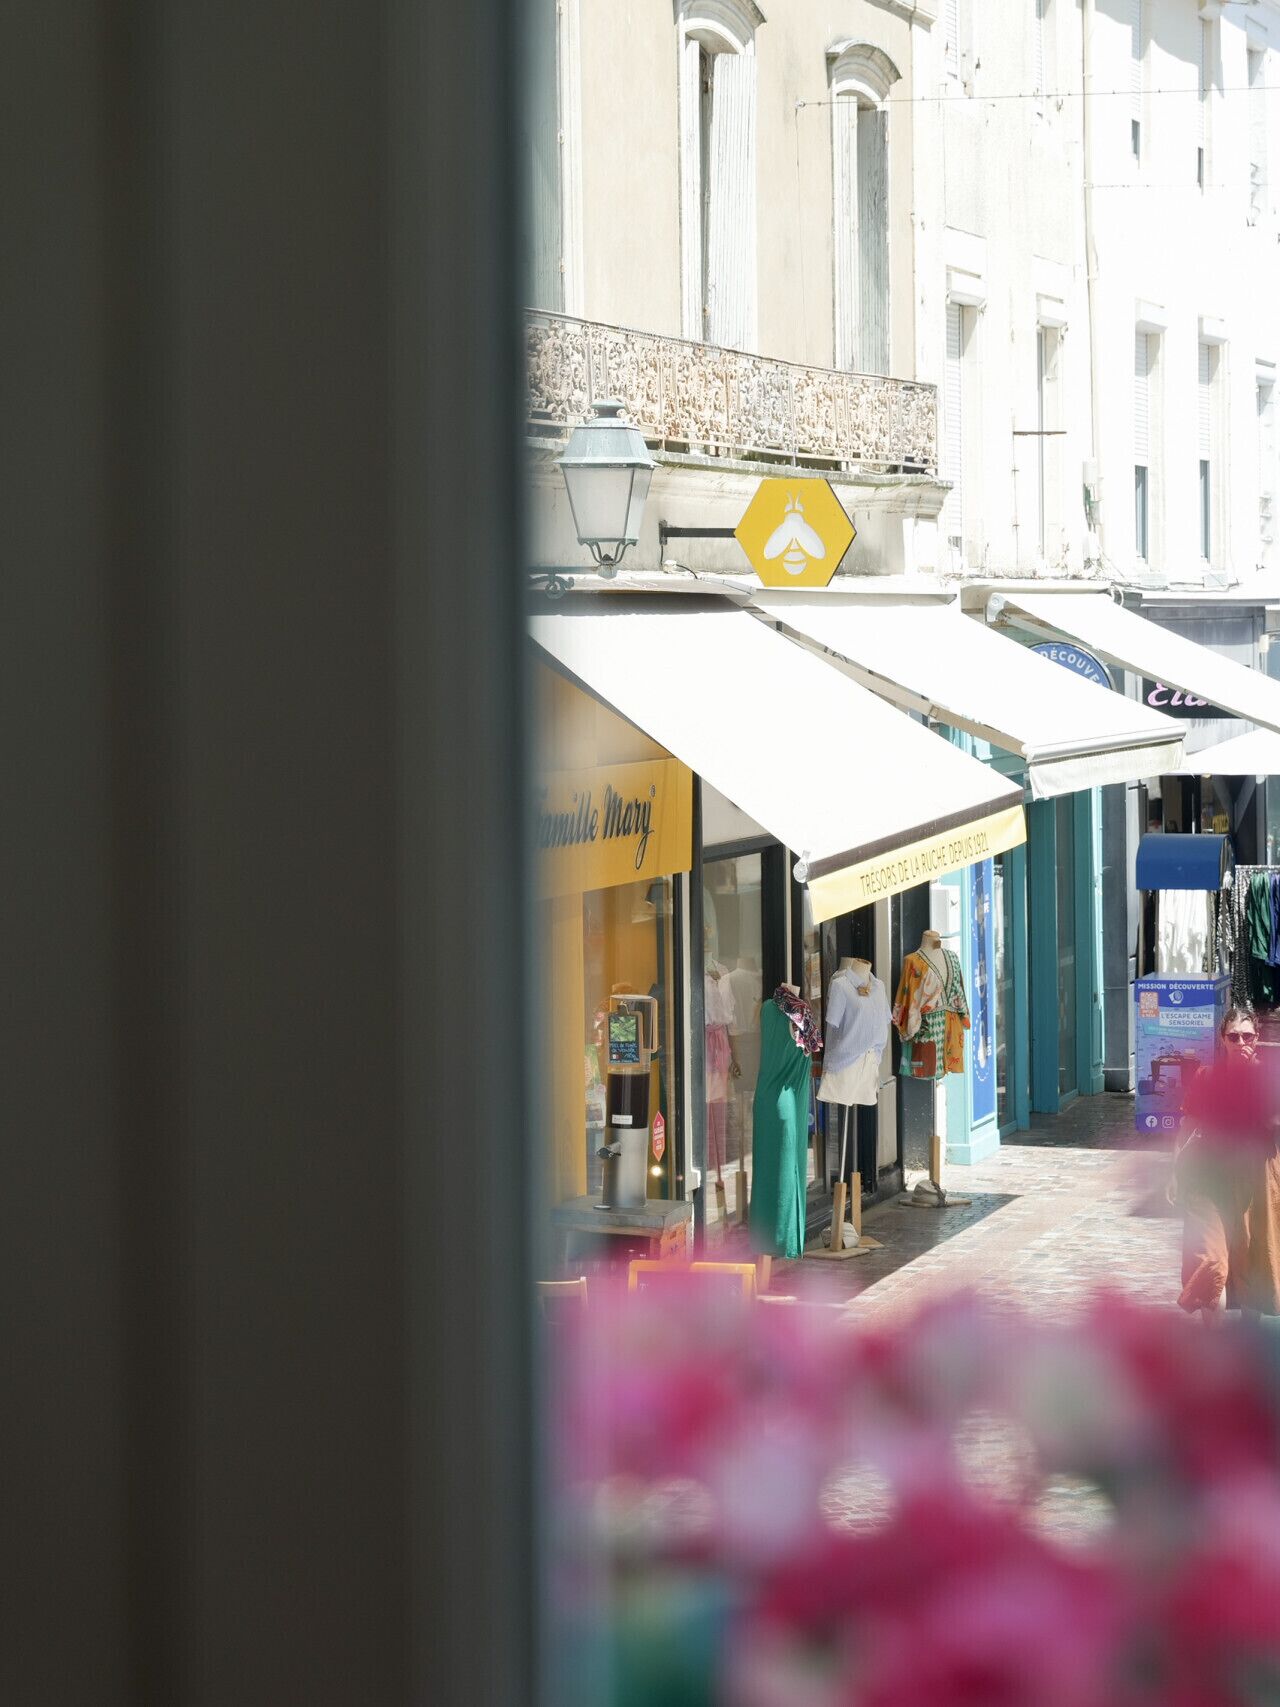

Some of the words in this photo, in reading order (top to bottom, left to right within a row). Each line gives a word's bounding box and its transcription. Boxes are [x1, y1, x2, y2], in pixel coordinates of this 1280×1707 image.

[860, 864, 897, 897] TRÉSORS
[898, 859, 909, 883] DE
[909, 856, 921, 878] LA
[921, 846, 948, 872] RUCHE
[949, 836, 973, 864] DEPUIS
[973, 832, 989, 856] 1921
[1169, 982, 1214, 990] DÉCOUVERTE
